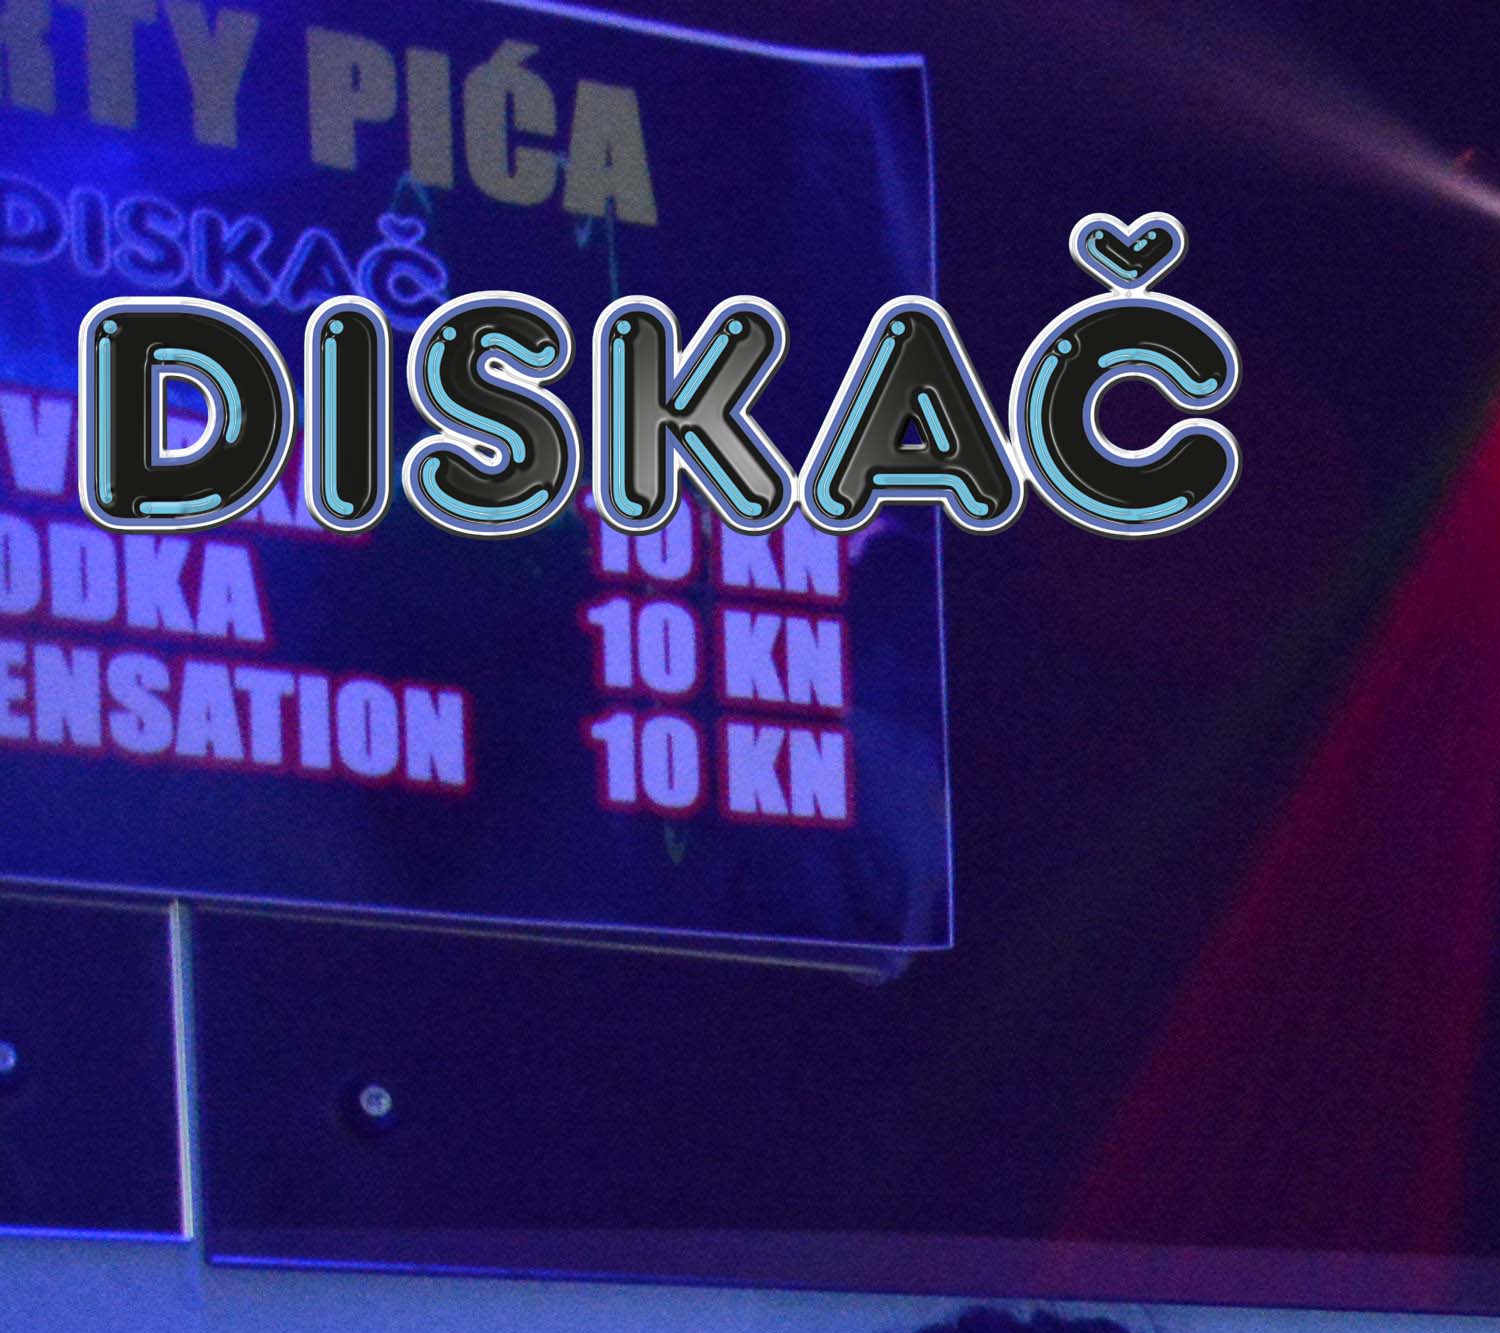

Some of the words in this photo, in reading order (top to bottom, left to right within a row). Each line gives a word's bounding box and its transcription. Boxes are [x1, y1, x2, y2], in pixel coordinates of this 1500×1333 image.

[305, 26, 657, 226] PIĆA
[586, 598, 697, 696] 10
[724, 608, 845, 708] KN
[590, 711, 700, 808] 10
[727, 722, 847, 820] KN
